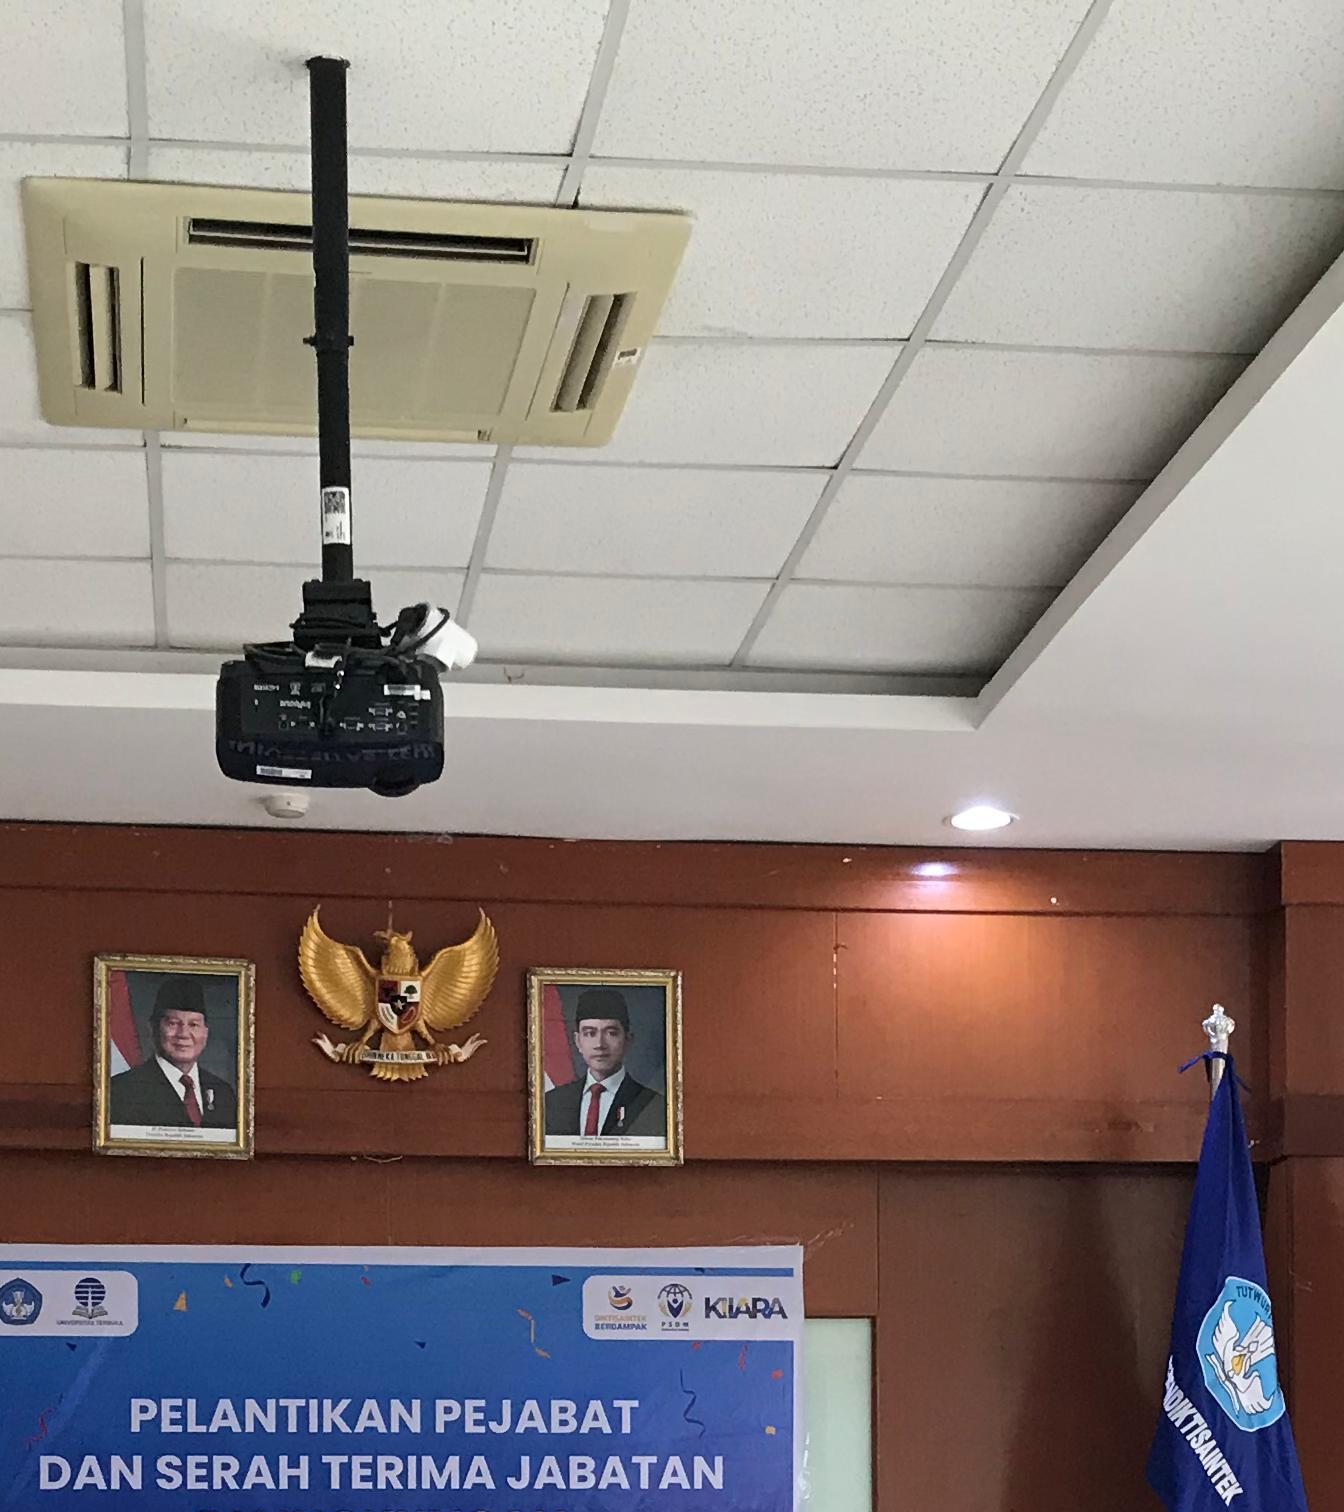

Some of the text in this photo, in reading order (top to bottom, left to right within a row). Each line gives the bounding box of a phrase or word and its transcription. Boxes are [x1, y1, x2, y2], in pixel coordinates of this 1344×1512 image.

[130, 1398, 639, 1434] PELANTIKAN PEJABAT
[38, 1454, 724, 1491] DAN SERAH TERIMA JABATAN
